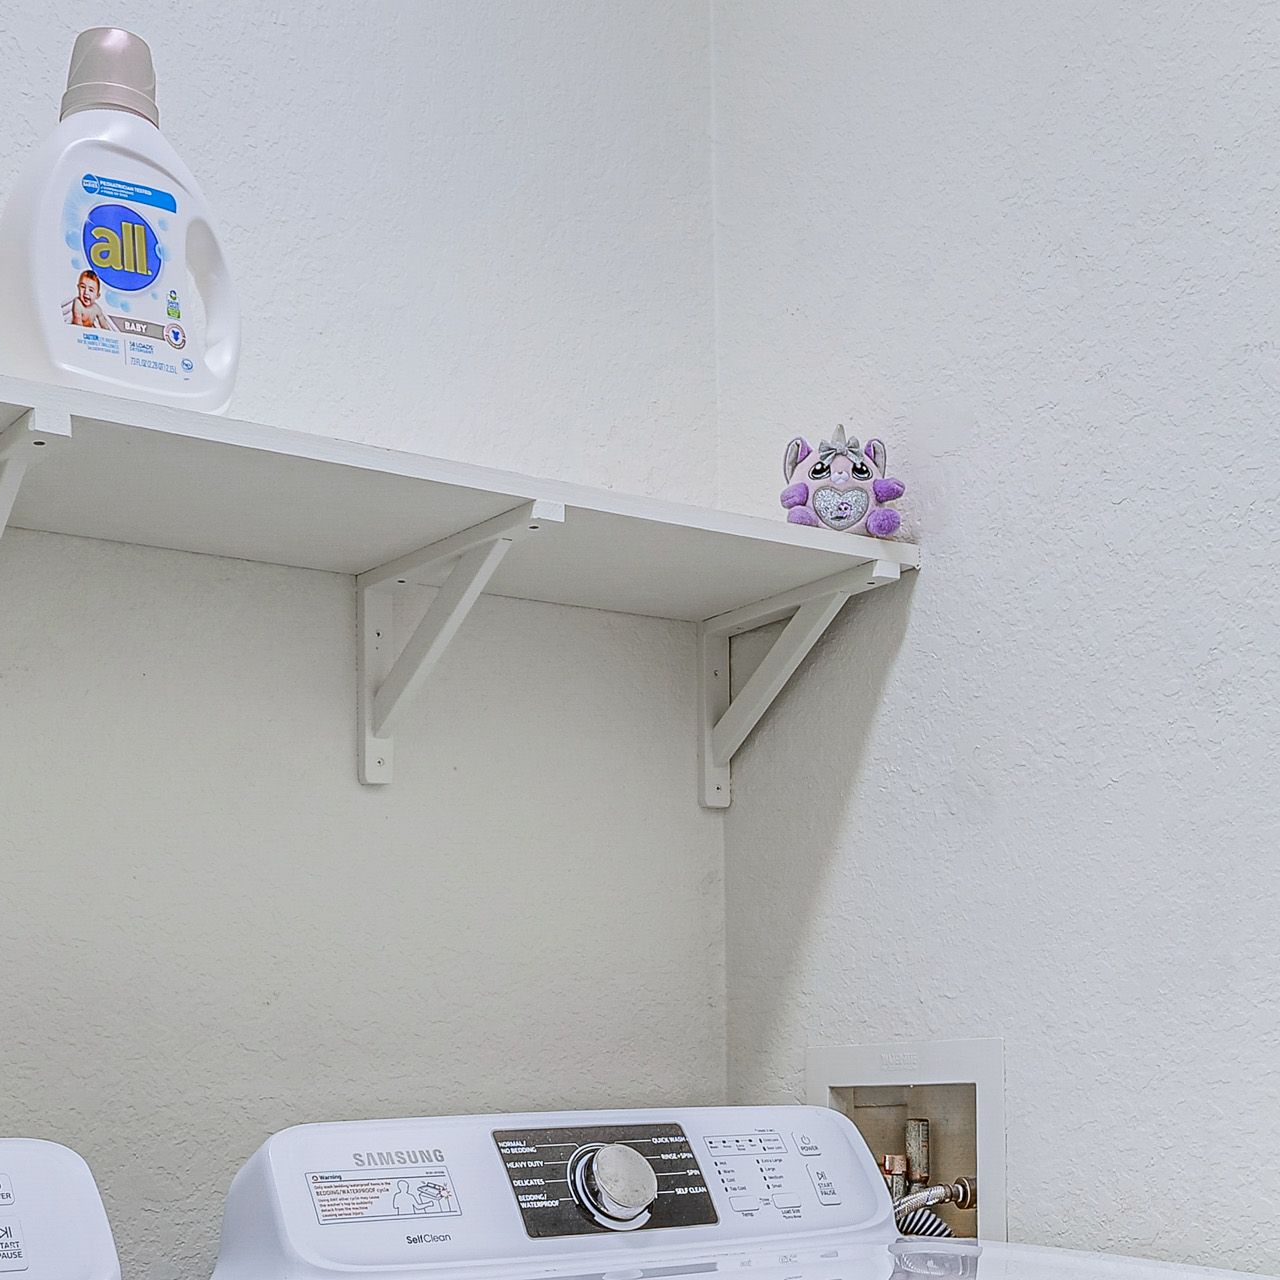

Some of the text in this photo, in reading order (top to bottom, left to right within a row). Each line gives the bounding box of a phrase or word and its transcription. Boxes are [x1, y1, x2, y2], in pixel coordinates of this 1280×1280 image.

[91, 221, 149, 275] all
[124, 321, 147, 333] BABY
[353, 1149, 445, 1167] SAMSUNG
[506, 1160, 544, 1169] HEAVY DUTY
[512, 1178, 545, 1187] DELICATES
[406, 1233, 452, 1244] SelfClean
